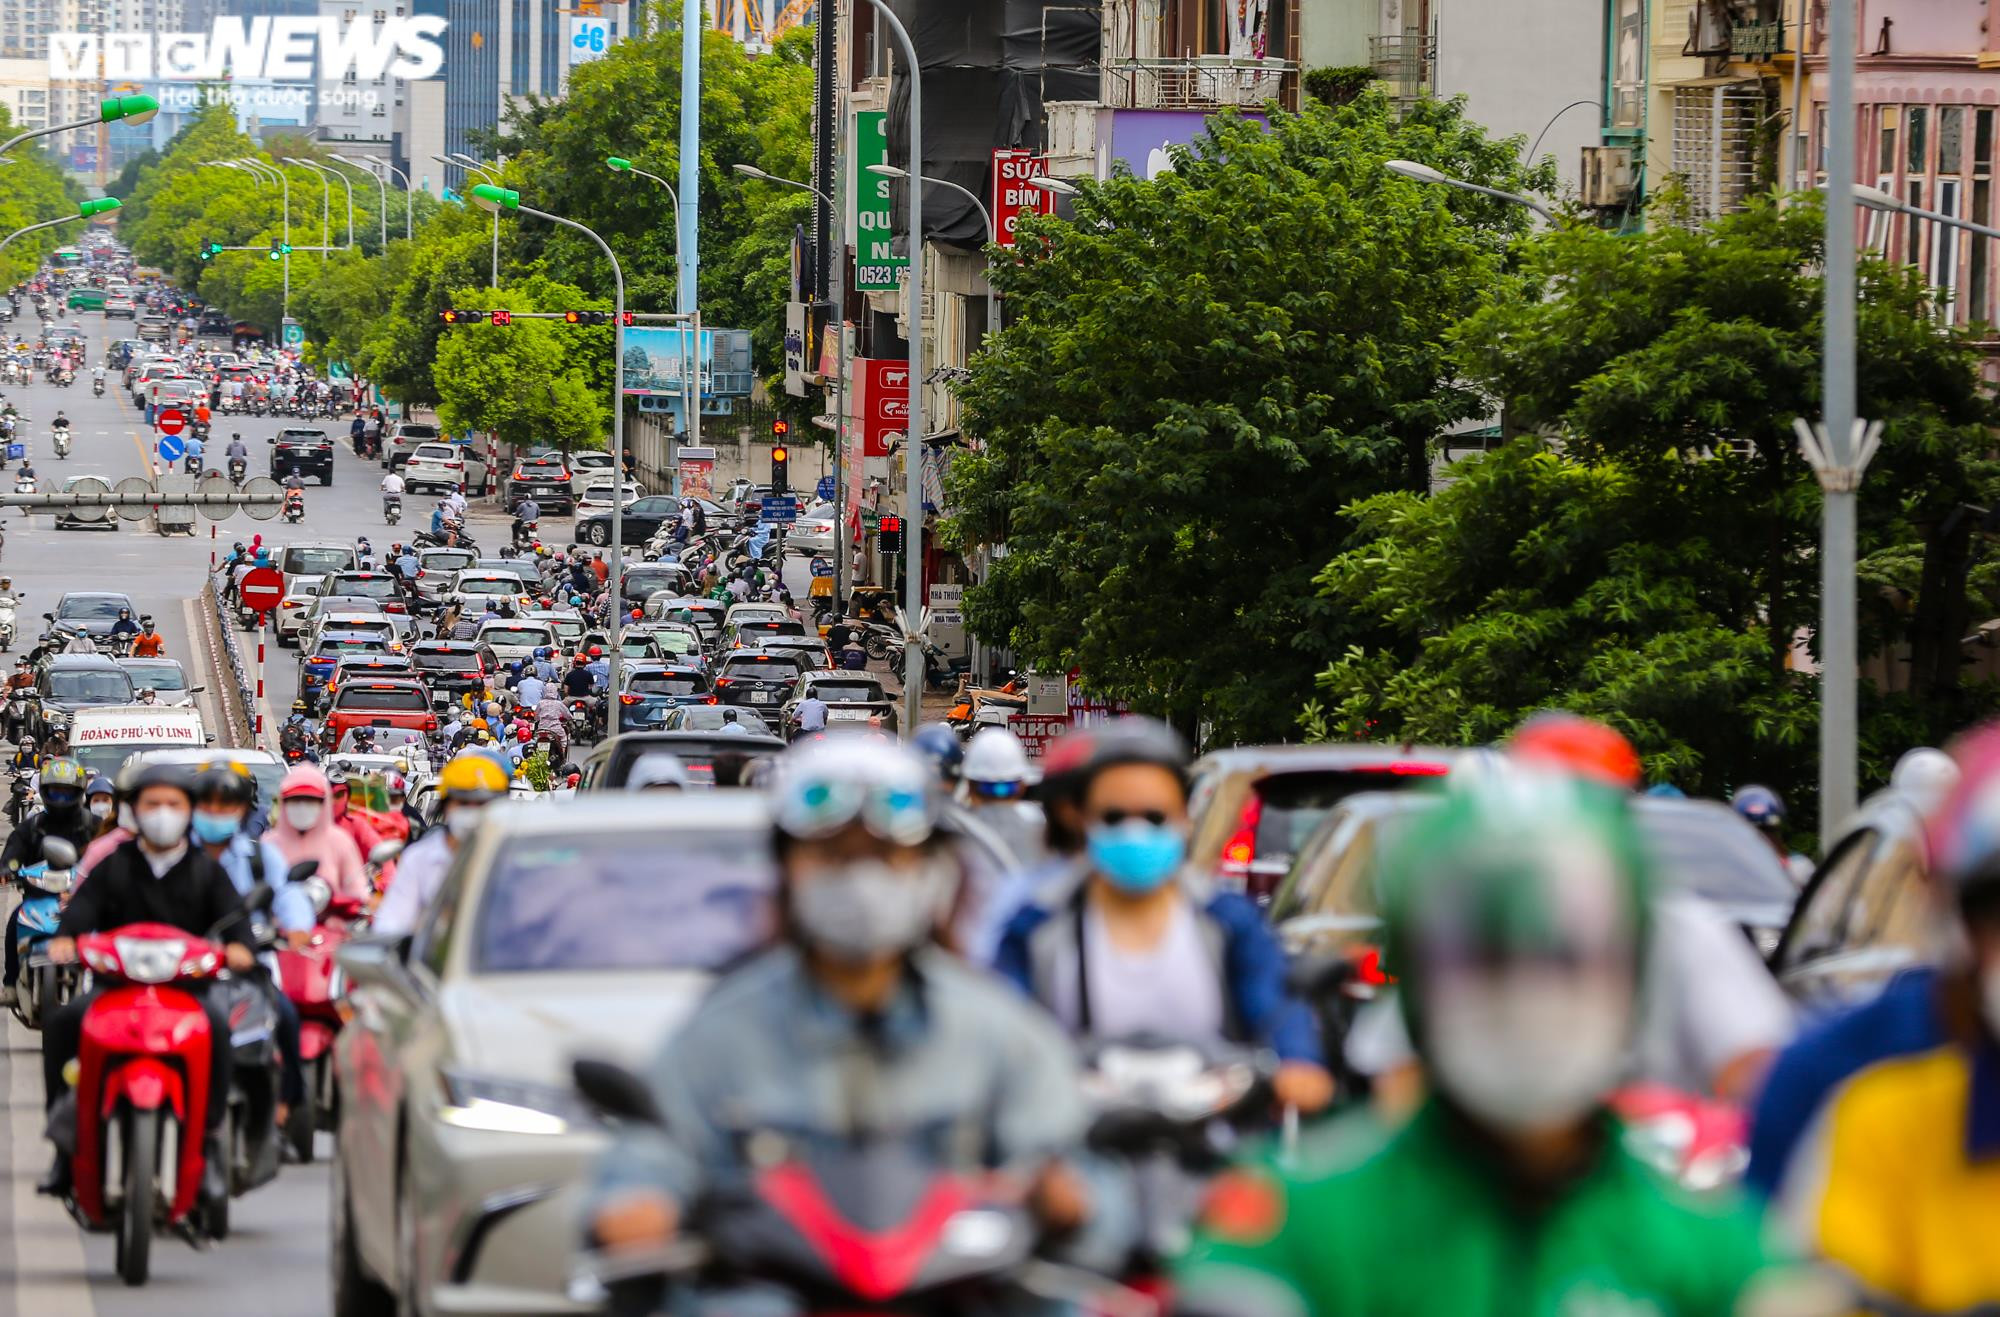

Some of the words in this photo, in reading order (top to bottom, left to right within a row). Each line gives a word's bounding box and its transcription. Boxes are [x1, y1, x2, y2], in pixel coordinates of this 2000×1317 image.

[1002, 158, 1045, 179] SỮA
[1005, 182, 1040, 206] BỈM
[859, 265, 892, 285] 0523
[492, 312, 509, 325] 24
[774, 422, 787, 433] 24
[80, 726, 118, 741] HOÀNG
[167, 727, 193, 739] LINH
